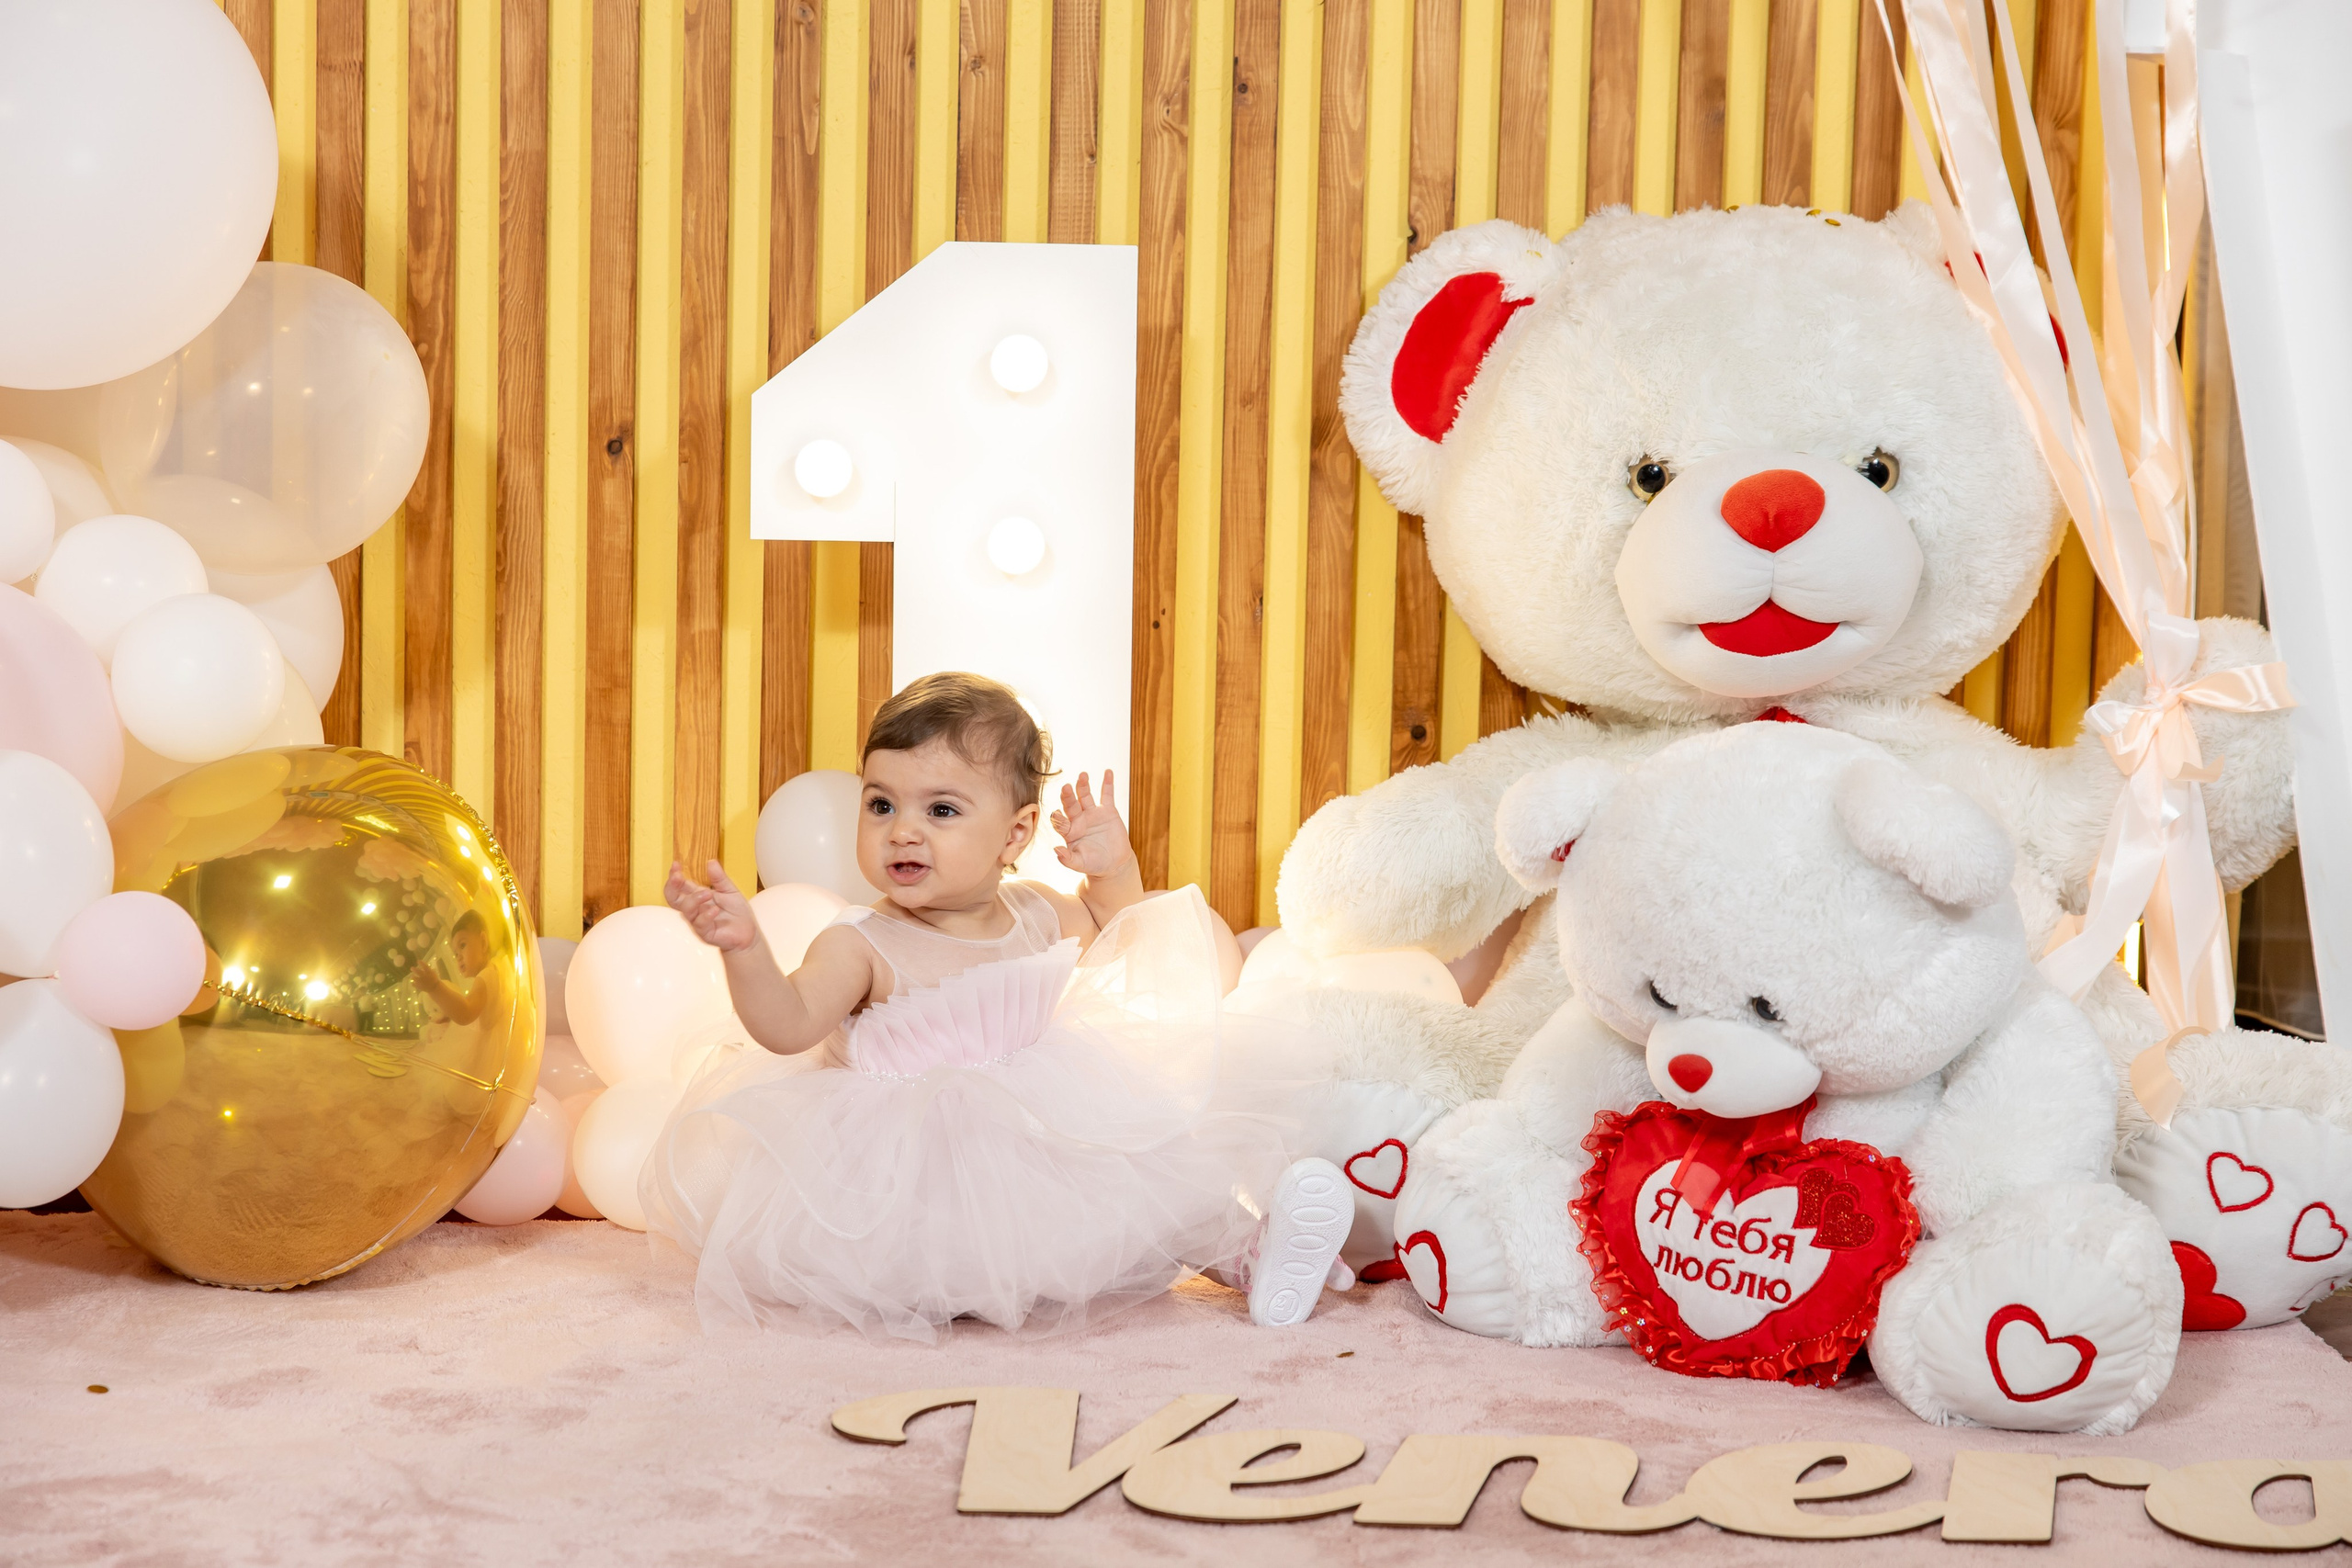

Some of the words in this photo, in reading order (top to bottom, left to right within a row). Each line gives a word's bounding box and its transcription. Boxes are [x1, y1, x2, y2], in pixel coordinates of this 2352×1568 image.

[1649, 1188, 1683, 1230] Я
[1693, 1209, 1795, 1264] тебя
[1273, 1294, 1296, 1312] 21
[1654, 1245, 1792, 1303] люблю
